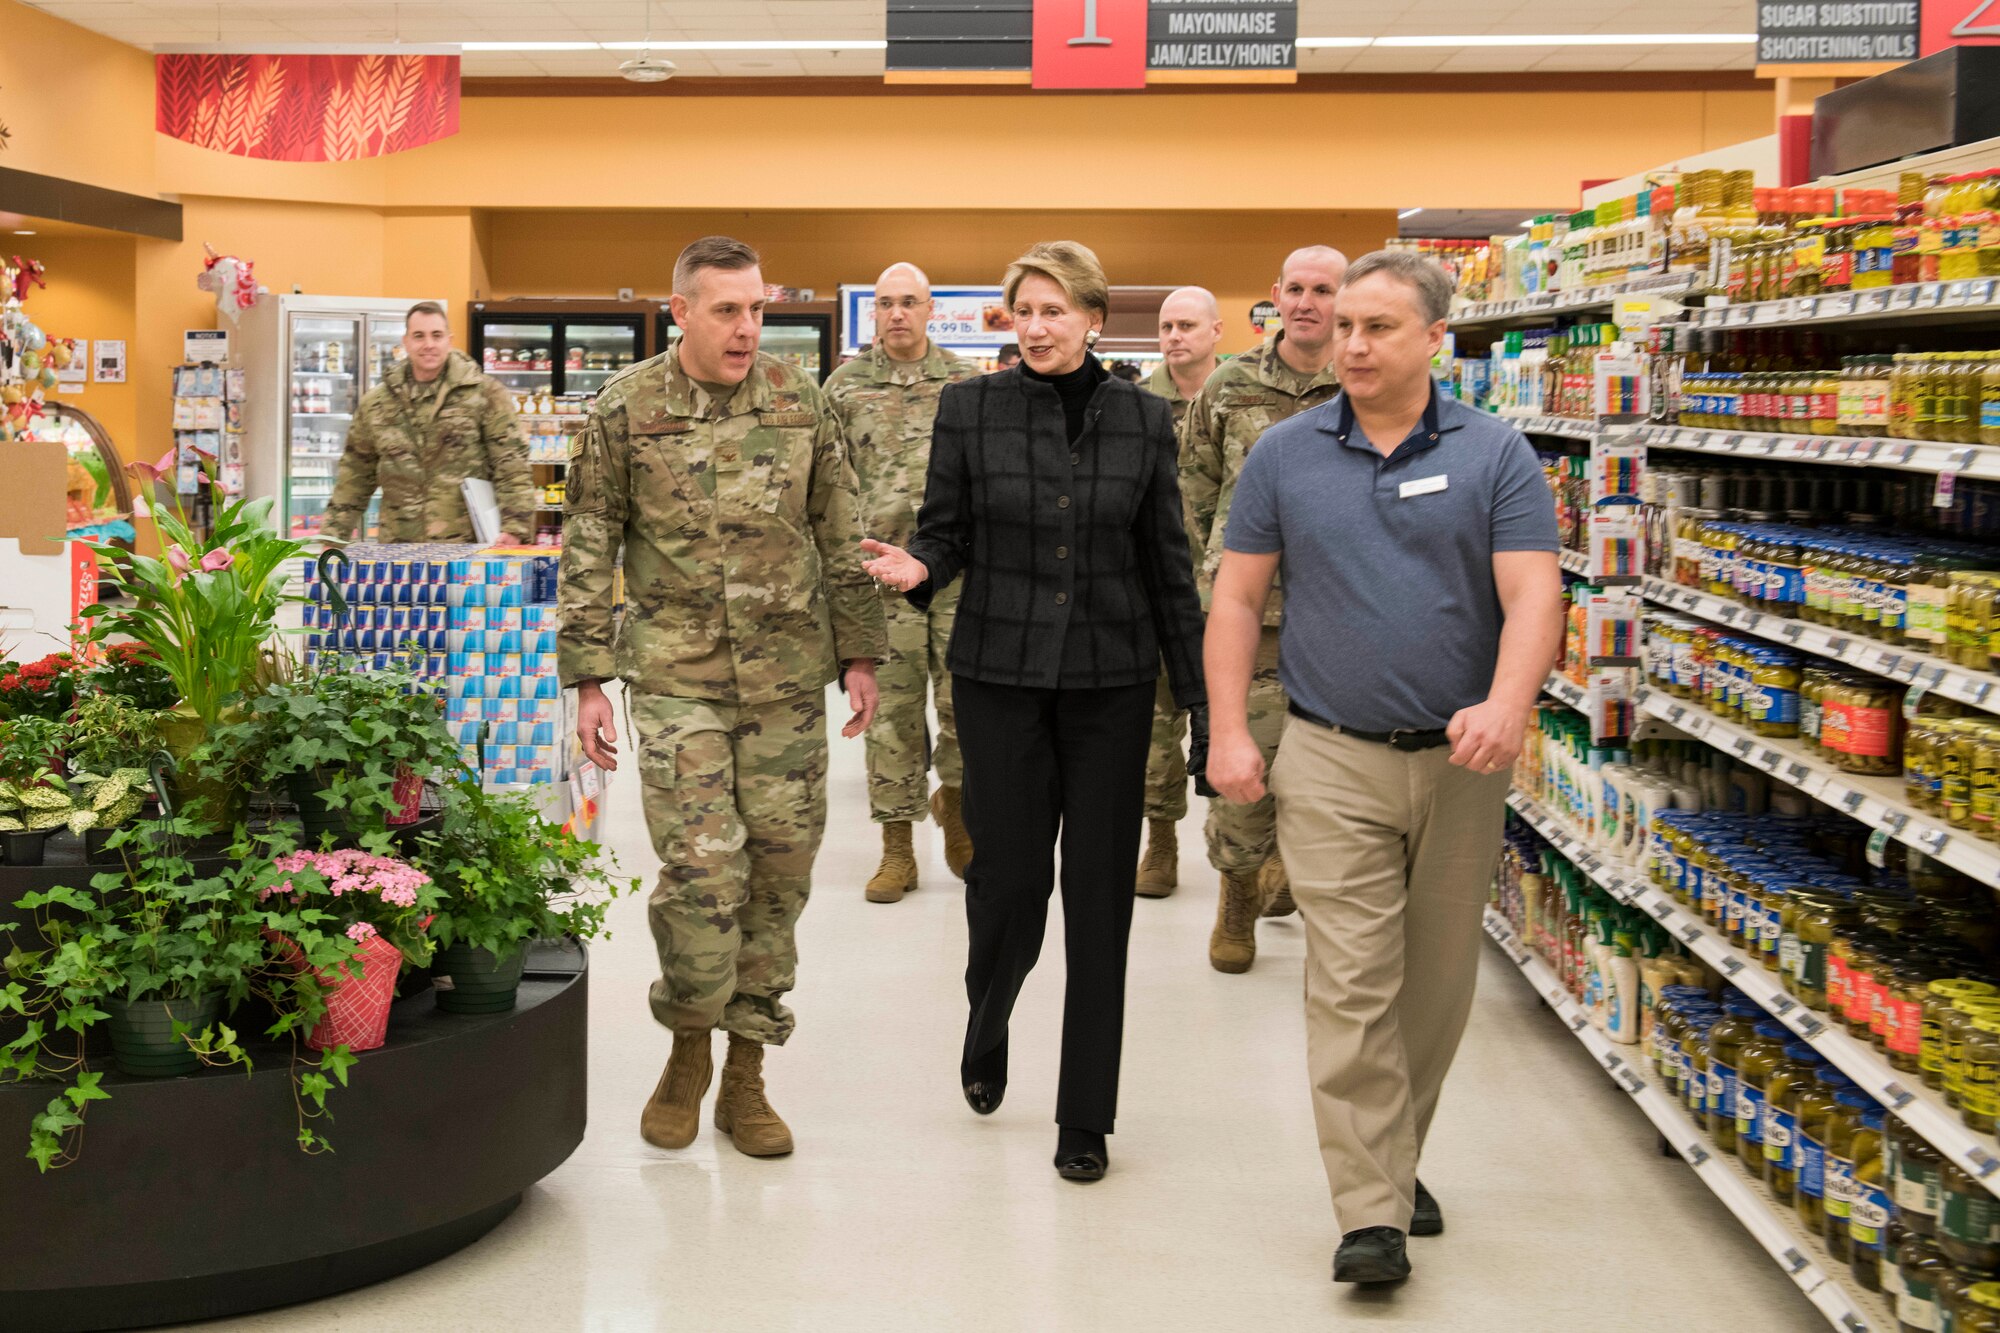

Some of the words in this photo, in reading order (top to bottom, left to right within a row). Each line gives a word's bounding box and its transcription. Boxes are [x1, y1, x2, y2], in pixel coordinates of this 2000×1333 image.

[1168, 12, 1276, 34] MAYONNAISE
[1761, 4, 1817, 28] SUGAR
[1820, 2, 1917, 26] SUBSTITUTE
[1150, 43, 1292, 67] JAM/JELLY/HONEY
[1761, 34, 1915, 60] SHORTENING/OILS
[960, 322, 977, 333] lb.
